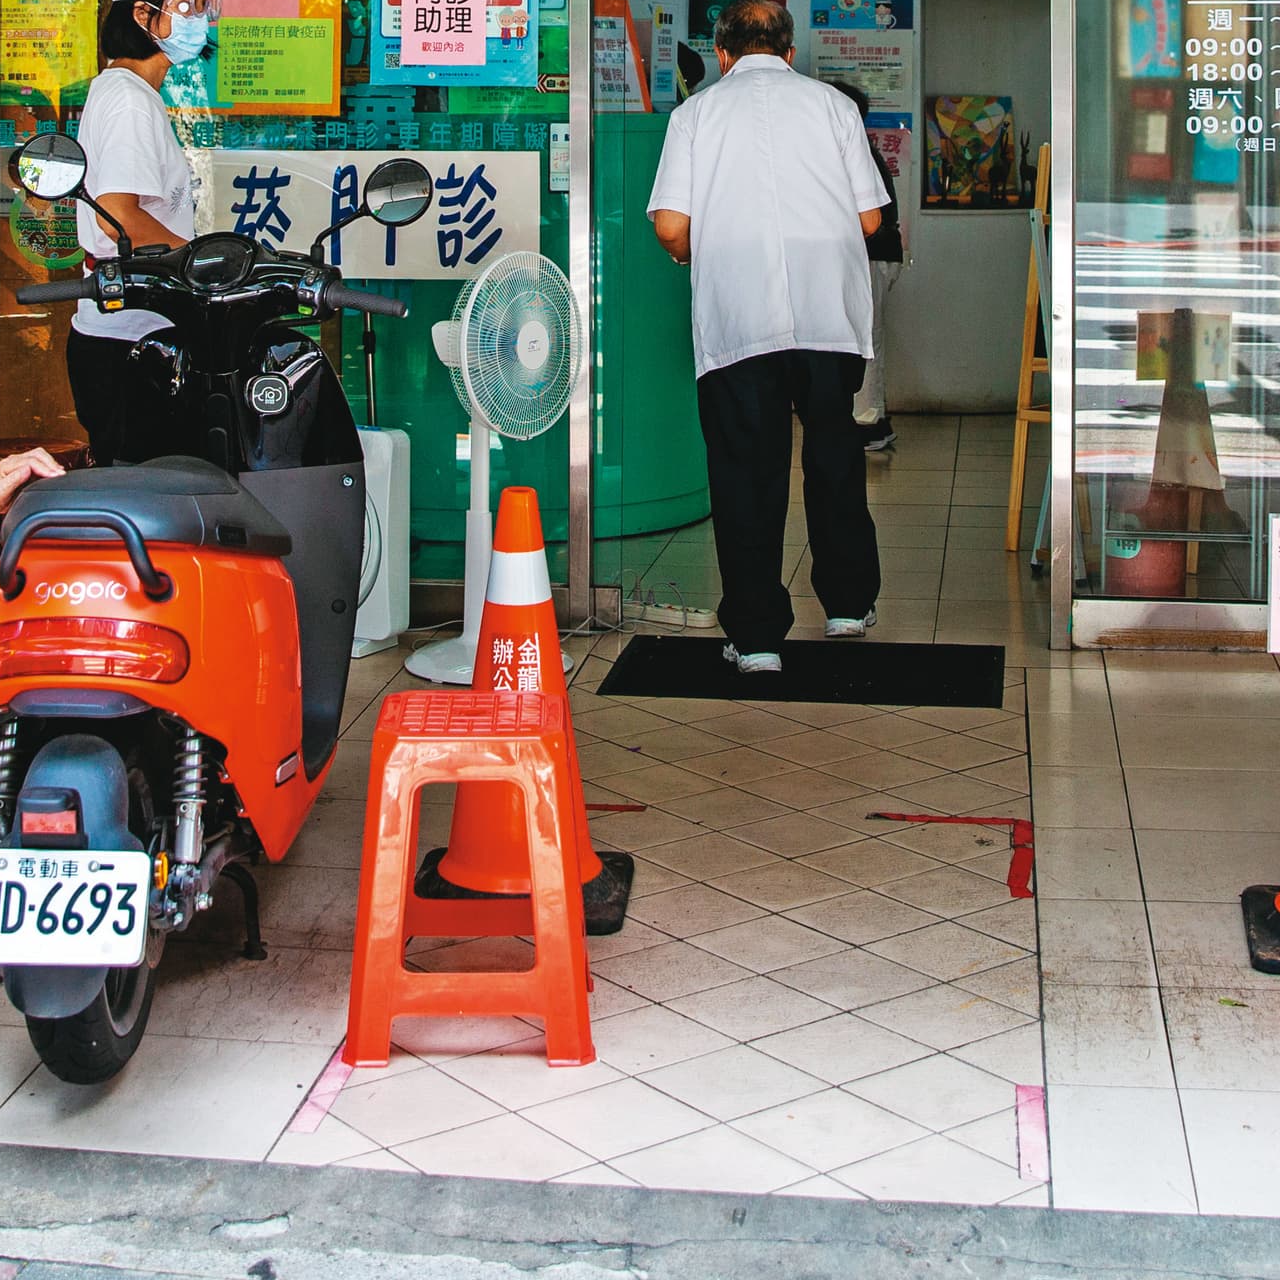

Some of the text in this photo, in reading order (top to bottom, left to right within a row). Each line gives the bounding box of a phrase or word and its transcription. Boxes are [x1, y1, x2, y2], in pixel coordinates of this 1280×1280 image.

[413, 6, 474, 34] 助理
[35, 579, 128, 606] gogoro
[17, 857, 80, 880] 電動車
